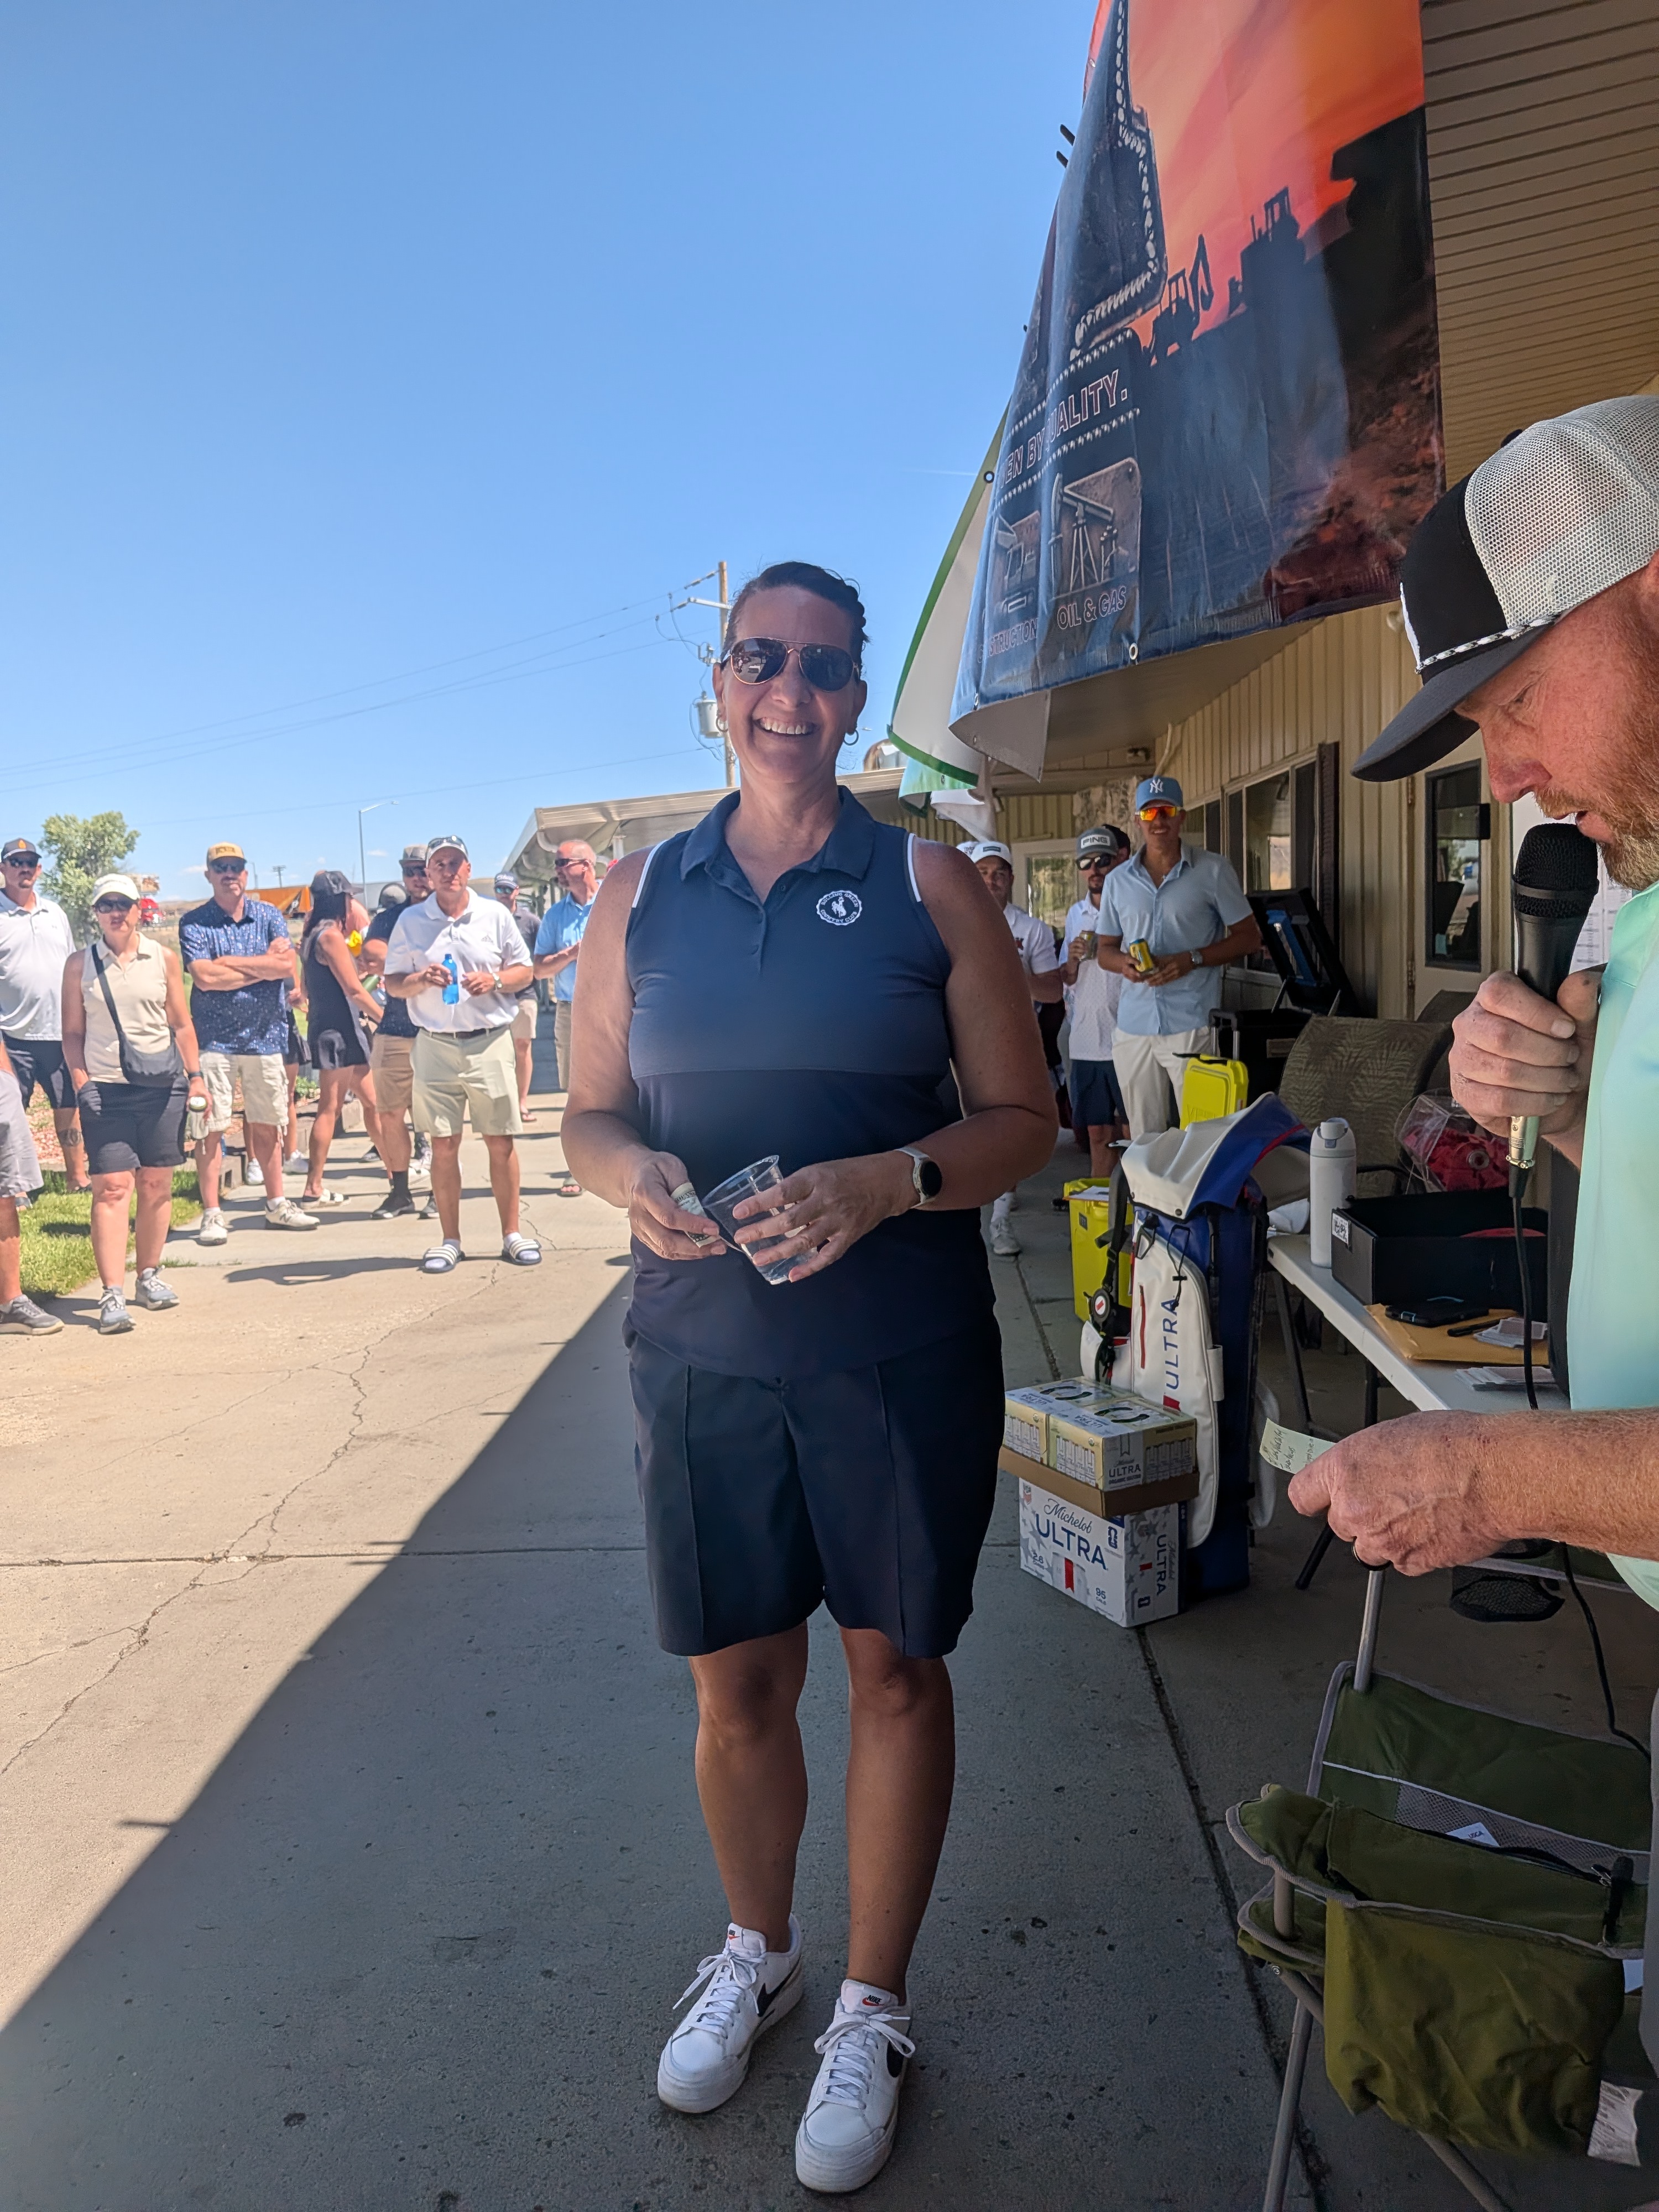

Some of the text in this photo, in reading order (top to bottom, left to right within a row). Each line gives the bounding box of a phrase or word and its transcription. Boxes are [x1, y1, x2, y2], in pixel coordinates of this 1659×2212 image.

[1026, 427, 1045, 469] BY
[1045, 369, 1128, 452] UALITY.
[1057, 586, 1126, 630] OIL & GAS
[1083, 837, 1108, 846] PING
[821, 892, 859, 907] ROLLING GREEN
[820, 909, 857, 923] COUNTRY CLUB
[1161, 1299, 1179, 1390] ULTRA
[1109, 1464, 1141, 1478] ULTRA
[1044, 1498, 1092, 1533] Michelob
[1035, 1514, 1107, 1570] ULTRA
[1157, 1534, 1167, 1596] ULTRA
[1095, 1587, 1106, 1600] 95
[867, 1994, 883, 2005] NIKE
